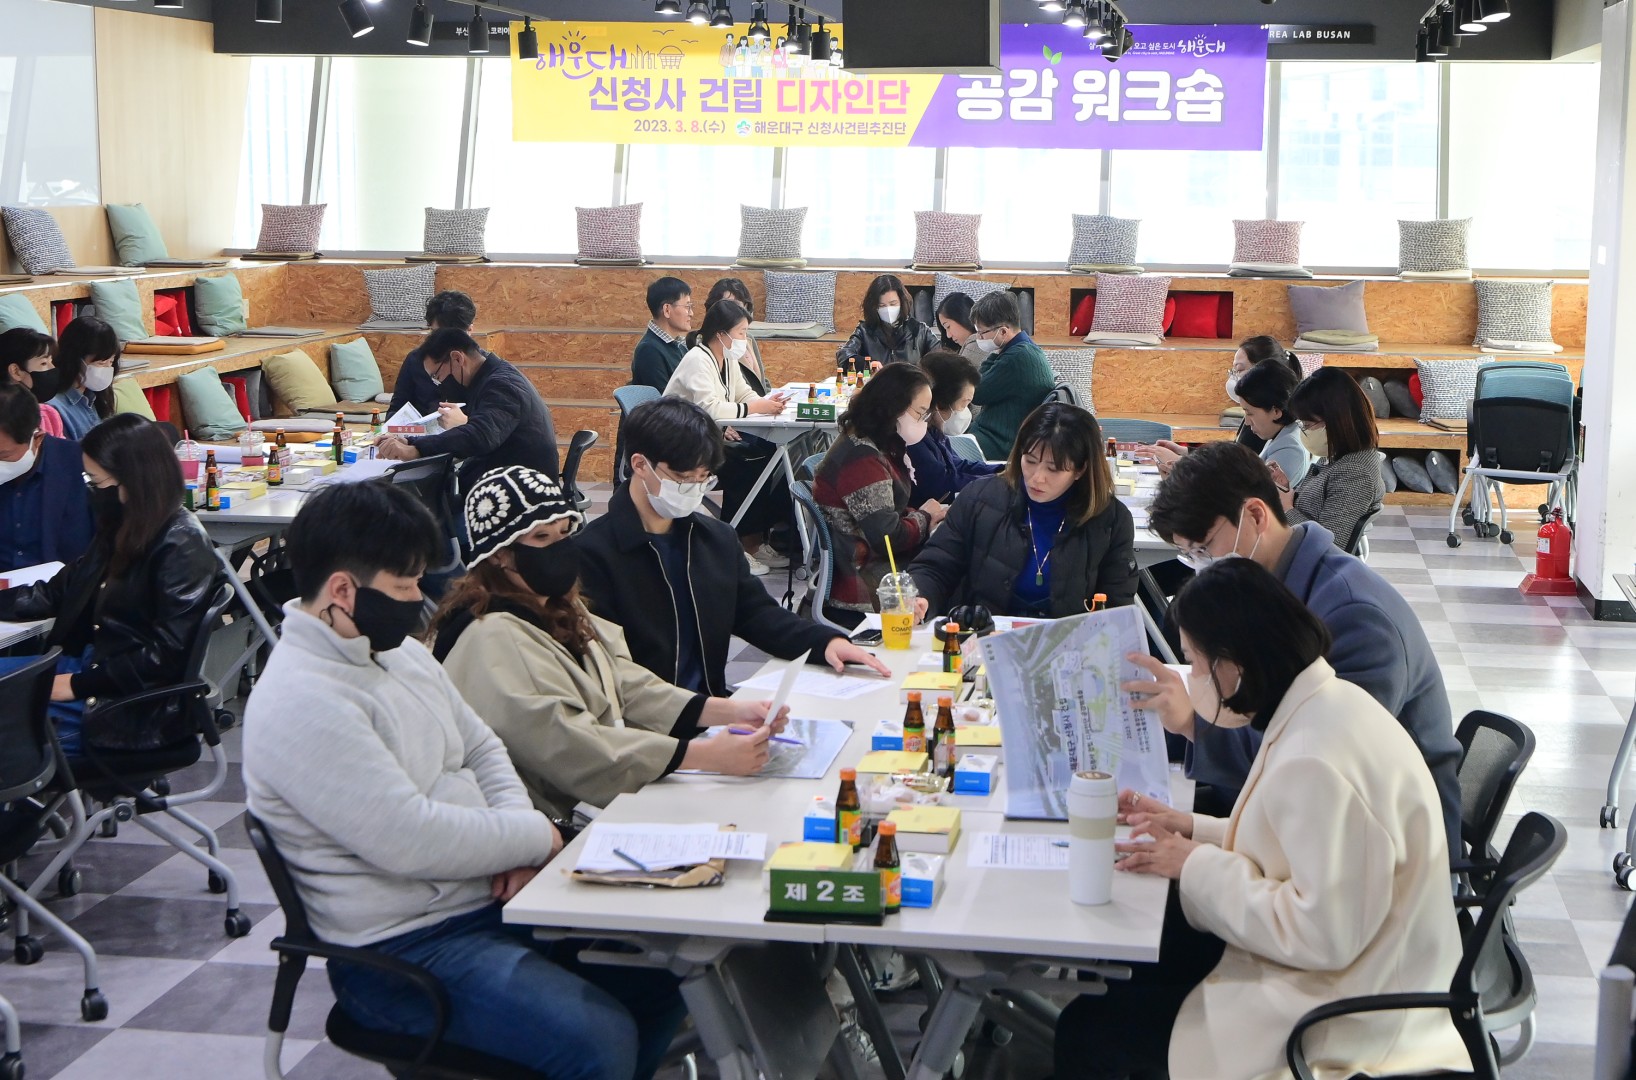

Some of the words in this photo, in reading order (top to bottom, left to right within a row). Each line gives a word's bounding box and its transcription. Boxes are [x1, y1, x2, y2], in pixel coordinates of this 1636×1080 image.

[1293, 30, 1312, 39] LAB
[1316, 30, 1351, 39] BUSAN
[1133, 42, 1147, 50] 오고
[1148, 42, 1161, 51] 싶은
[1162, 42, 1176, 50] 도시
[1177, 37, 1226, 58] 해운대
[536, 40, 627, 80] 해운대
[589, 76, 687, 113] 신청사
[700, 78, 762, 114] 건립
[776, 79, 911, 115] 디자인단
[956, 68, 1059, 121] 공감
[1072, 68, 1225, 122] 워크숍
[633, 119, 672, 133] 2023.
[675, 119, 688, 133] 3.
[690, 119, 726, 135] 8.(수)
[754, 121, 804, 136] 해운대구
[807, 121, 907, 137] 신청사건립추진단
[813, 407, 820, 416] 5
[784, 883, 807, 901] 제
[816, 880, 835, 901] 2
[842, 885, 865, 902] 조
